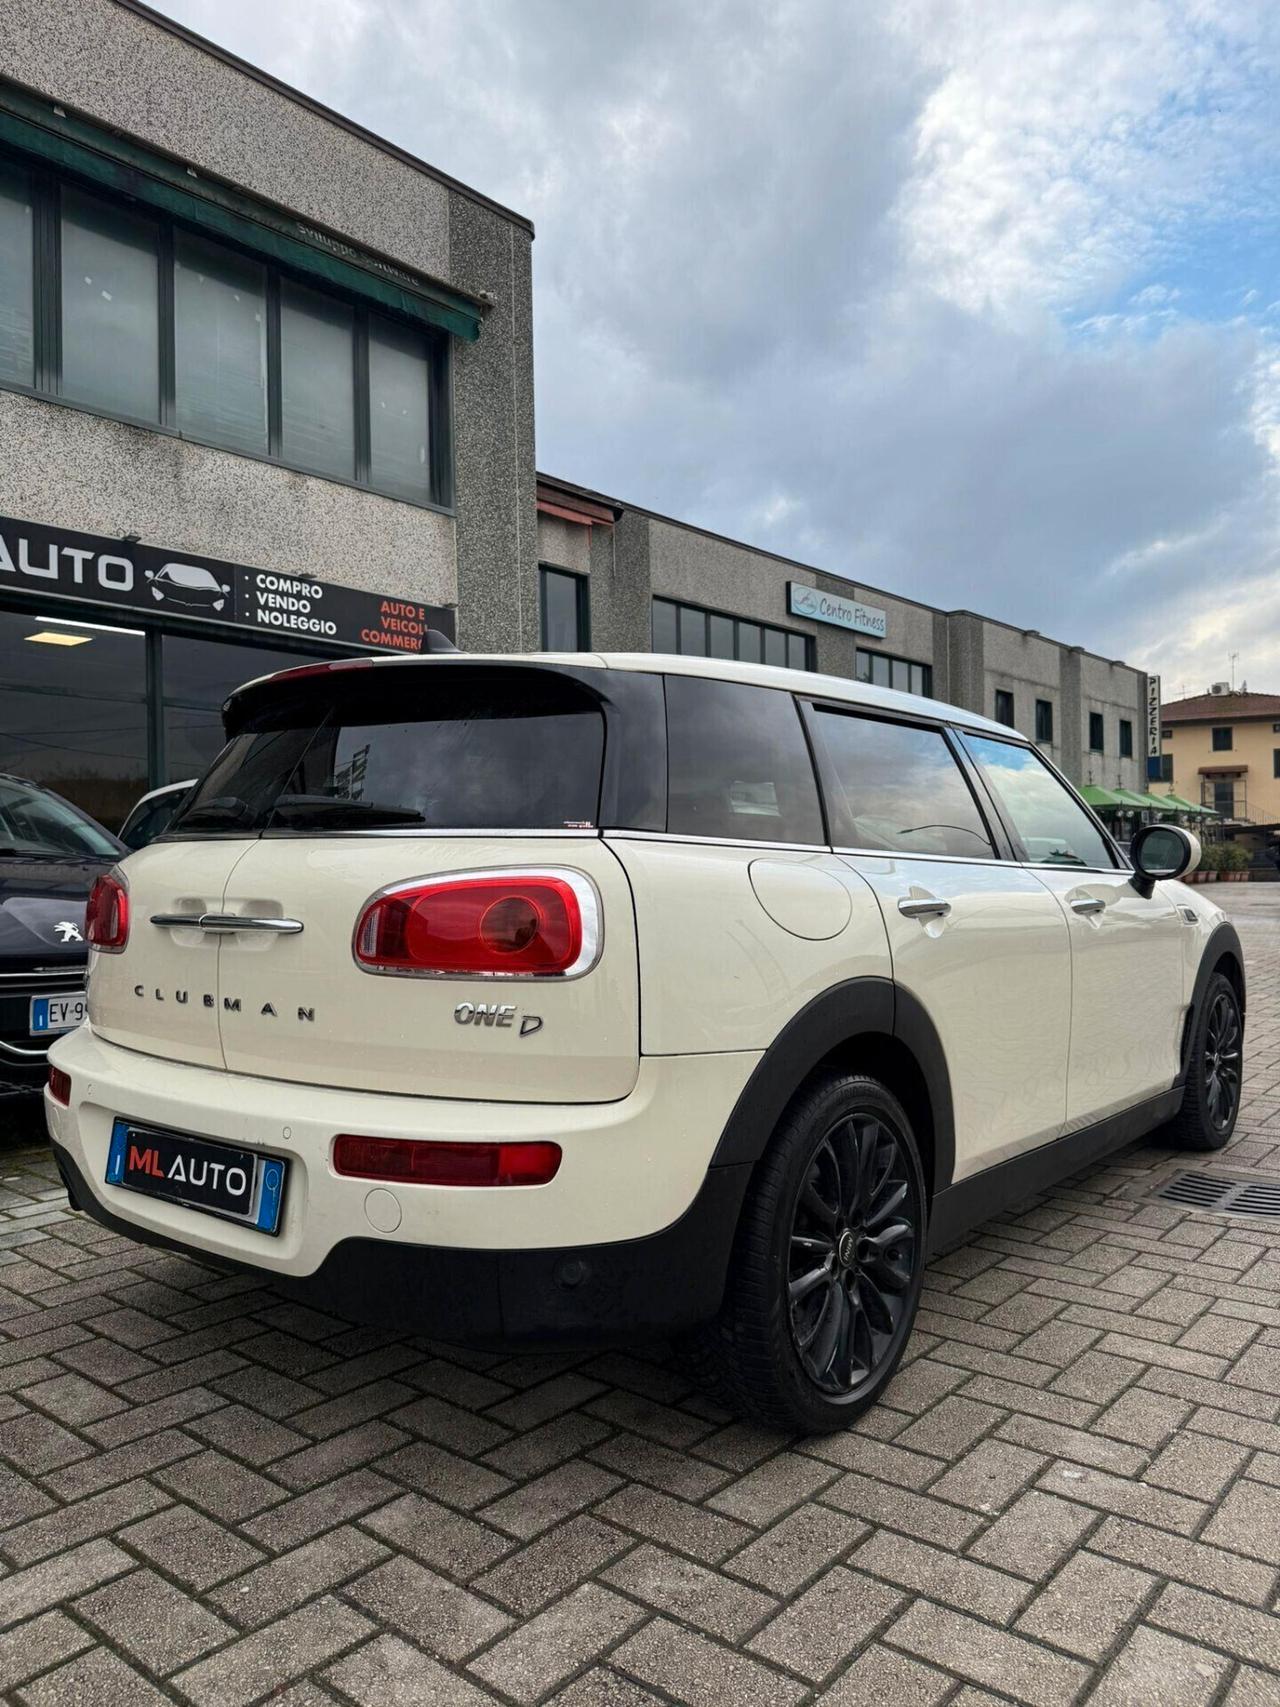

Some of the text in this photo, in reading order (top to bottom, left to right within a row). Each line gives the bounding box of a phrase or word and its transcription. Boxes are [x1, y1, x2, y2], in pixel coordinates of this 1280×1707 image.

[256, 574, 323, 599] COMPRO
[256, 591, 311, 613] VENDO
[257, 609, 337, 635] NOLEGGIO
[380, 600, 425, 620] AUTO E
[820, 598, 885, 632] Centro Fitness
[1148, 676, 1158, 755] PIZZERIA
[134, 984, 315, 1021] CLUBMAN
[454, 1001, 543, 1038] ONE D
[129, 1145, 247, 1196] ML AUTO
